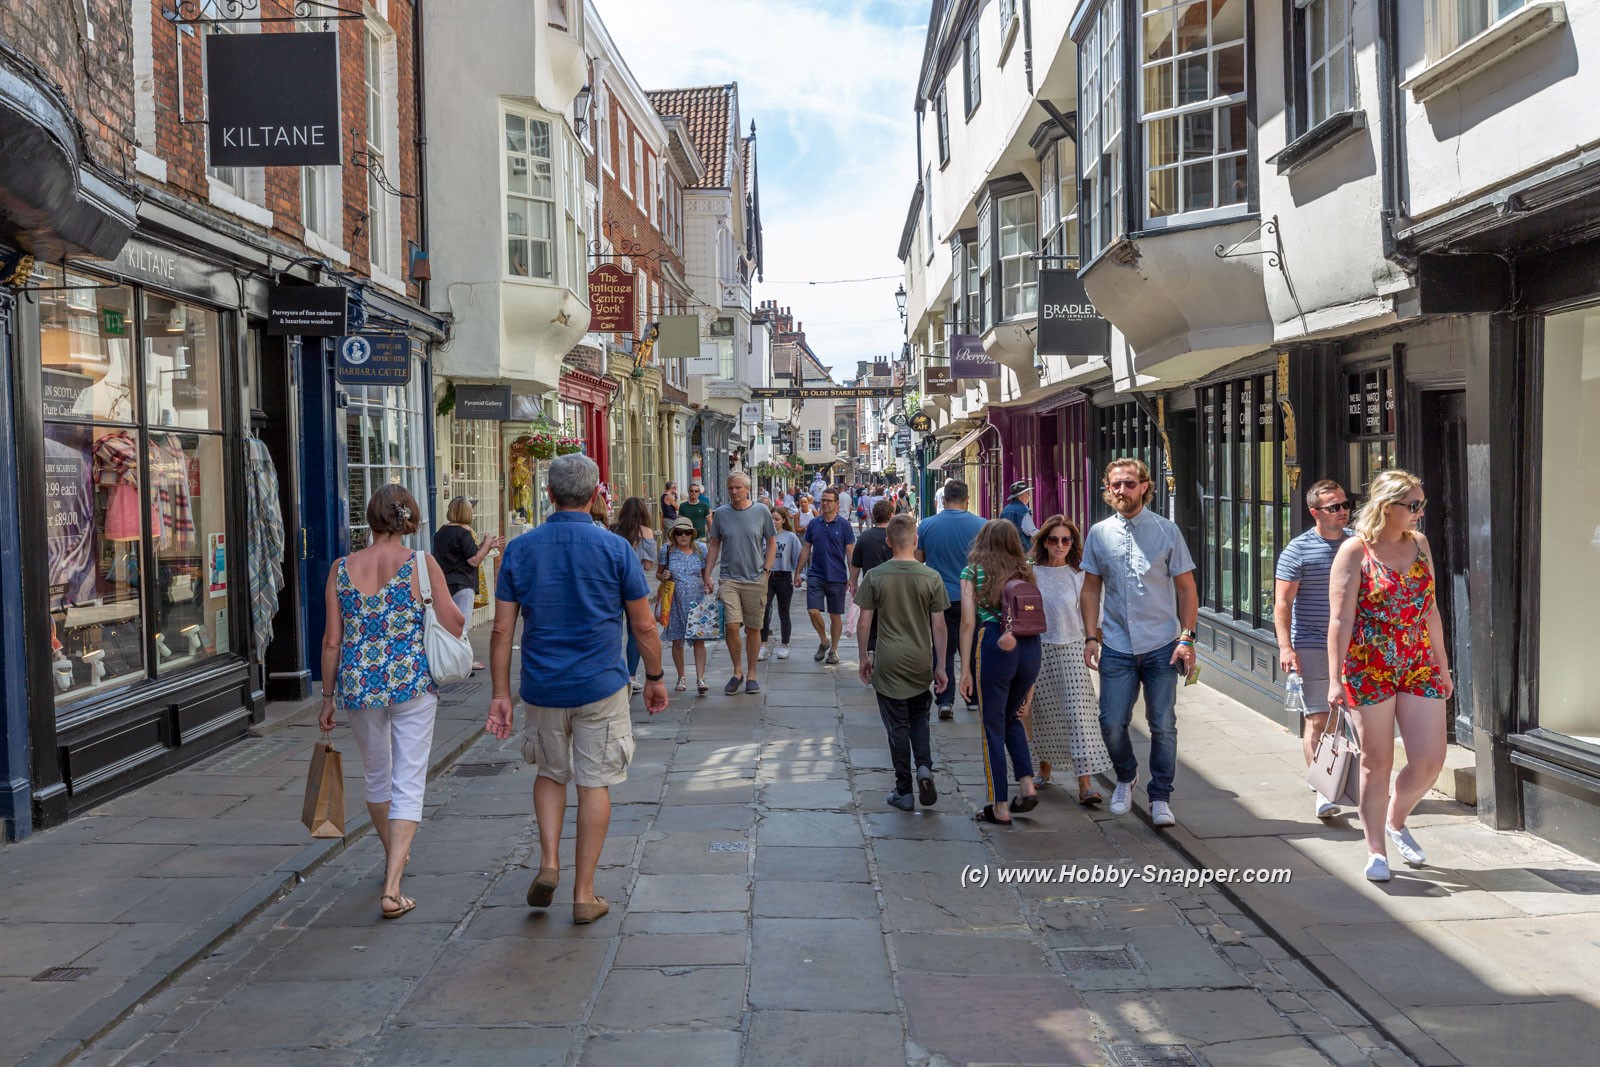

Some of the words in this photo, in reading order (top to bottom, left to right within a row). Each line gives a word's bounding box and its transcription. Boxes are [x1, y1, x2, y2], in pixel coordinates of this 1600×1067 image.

[222, 125, 325, 148] KILTANE
[128, 244, 175, 280] KILTANE
[599, 272, 619, 283] The
[589, 283, 632, 295] Antiques
[591, 293, 626, 304] Centre
[595, 304, 621, 315] York
[338, 367, 376, 376] BARBARA
[44, 385, 53, 396] IN
[43, 403, 58, 415] Pure
[56, 464, 77, 473] SCARVES
[60, 482, 77, 495] each
[55, 512, 78, 526] £89.00
